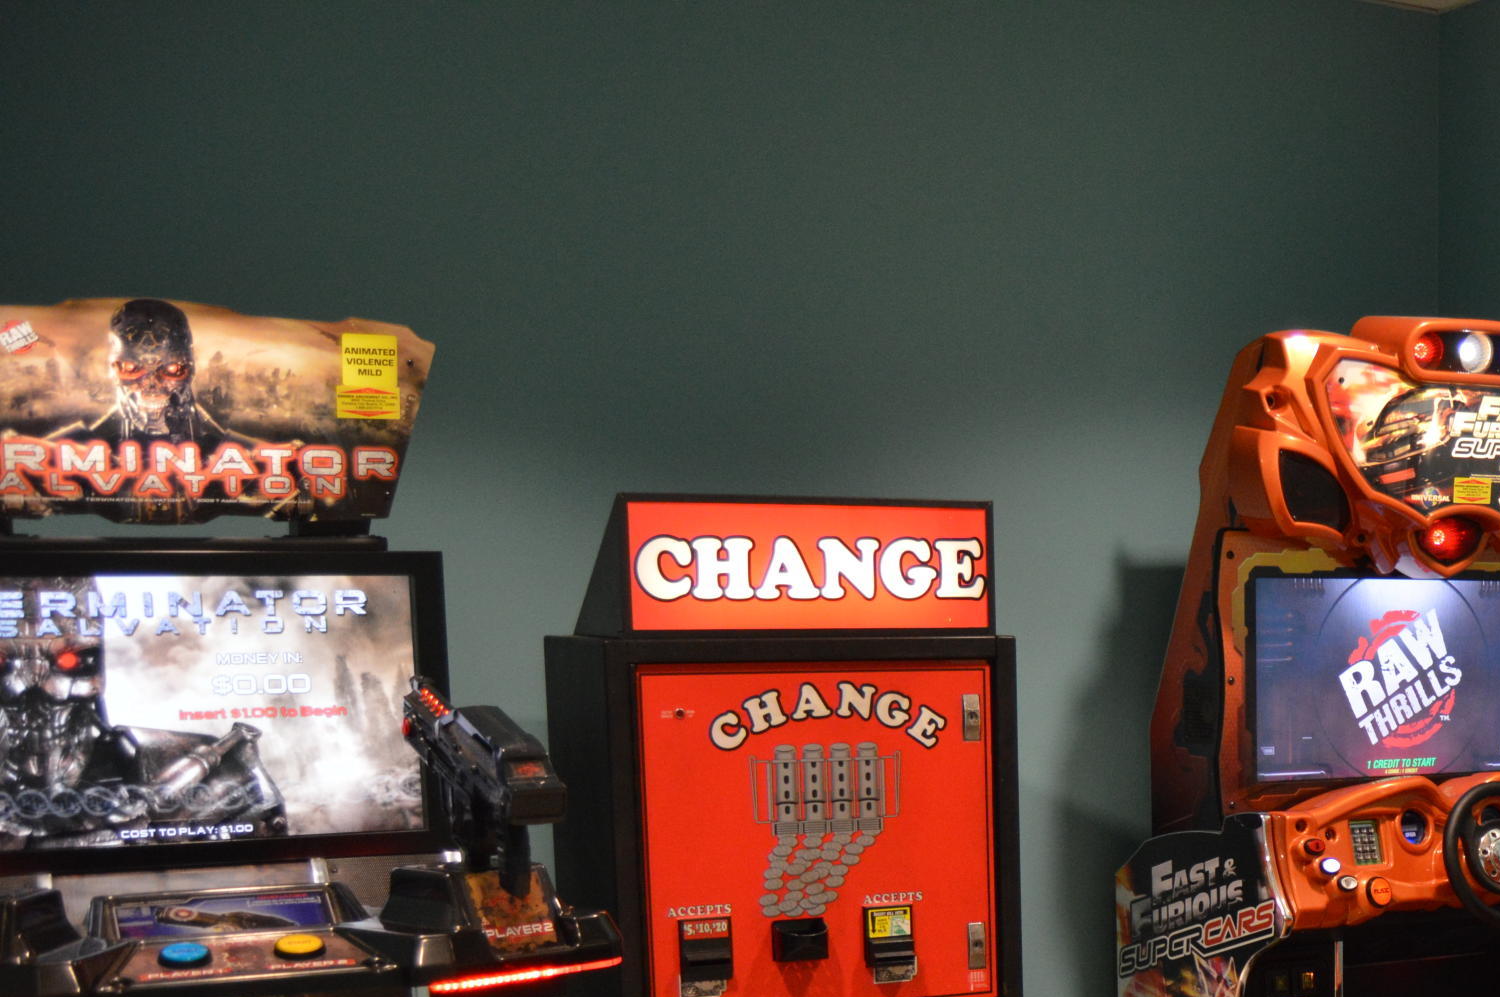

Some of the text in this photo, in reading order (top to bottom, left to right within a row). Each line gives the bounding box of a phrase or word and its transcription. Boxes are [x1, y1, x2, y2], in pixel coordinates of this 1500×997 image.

[344, 347, 396, 356] ANIMATED
[346, 357, 395, 366] VIOLENCE
[3, 444, 397, 479] RMINATOR
[0, 473, 342, 495] ALVATION
[634, 534, 988, 602] CHANGE
[216, 651, 304, 665] MONEY IN:
[1338, 609, 1449, 719] RAW
[212, 673, 312, 697] $0.00
[1358, 655, 1463, 746] THRILLS
[179, 704, 349, 720] Insert $1.00 to Begin
[707, 680, 947, 751] CHANGE
[1373, 759, 1401, 769] CREDIT
[1401, 758, 1412, 768] TO
[1412, 757, 1437, 767] START
[120, 823, 254, 840] COST TO PLAY: $1.00
[1151, 857, 1237, 898] FAST &
[863, 891, 923, 905] ACCEPTS
[667, 904, 732, 917] ACCEPTS
[1131, 880, 1243, 937] FURIOUS
[485, 922, 555, 938] PLAYER 2
